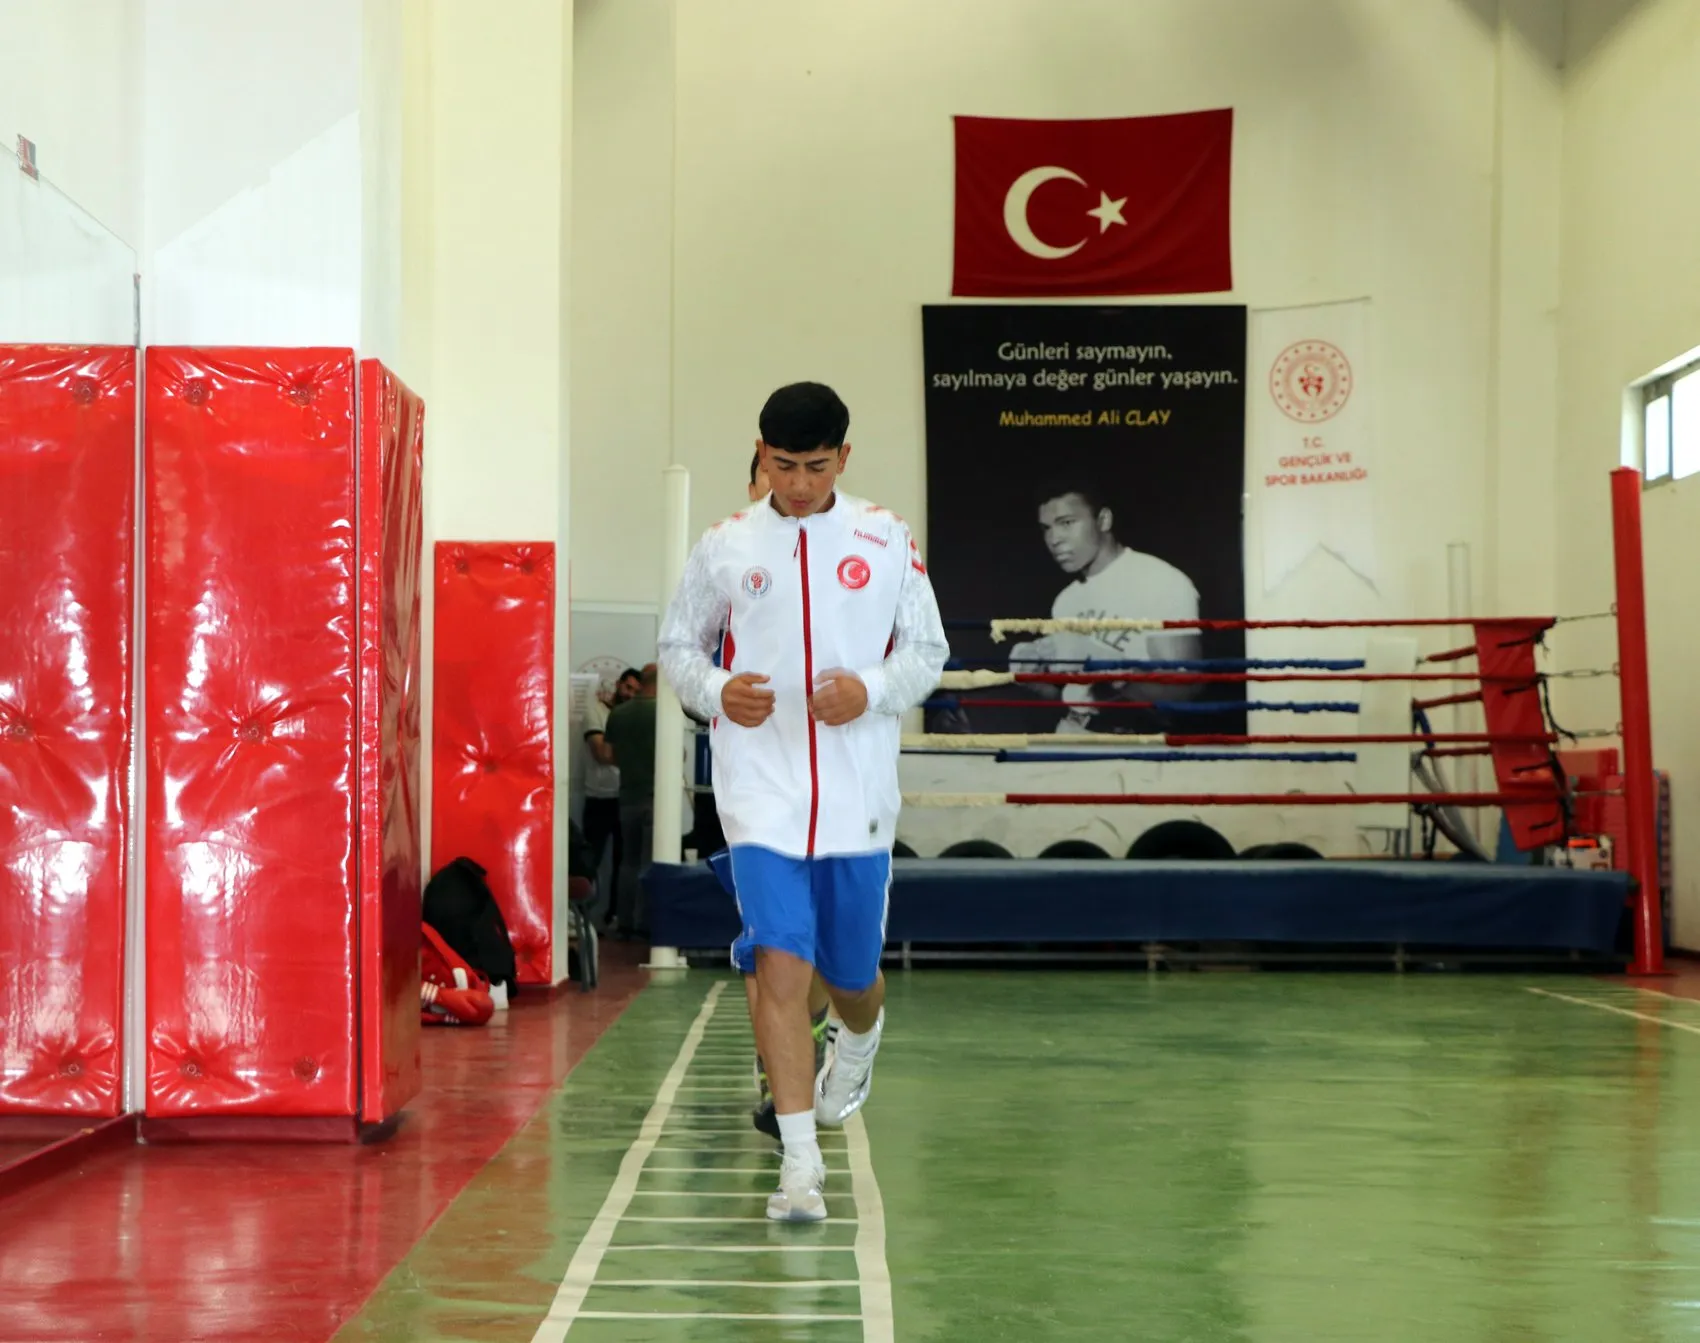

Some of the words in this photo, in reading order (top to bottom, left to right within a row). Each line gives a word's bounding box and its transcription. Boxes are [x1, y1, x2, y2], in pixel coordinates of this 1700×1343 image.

[997, 341, 1070, 361] Günleri
[932, 369, 1028, 391] sayılmaya
[1032, 368, 1088, 391] değer
[1093, 367, 1155, 391] günler
[1160, 369, 1240, 389] yaşayın.
[999, 410, 1092, 427] Muhammed
[1097, 410, 1121, 426] Ali
[1125, 409, 1172, 426] CLAY
[1335, 451, 1352, 464] VE
[1264, 474, 1297, 487] SPOR
